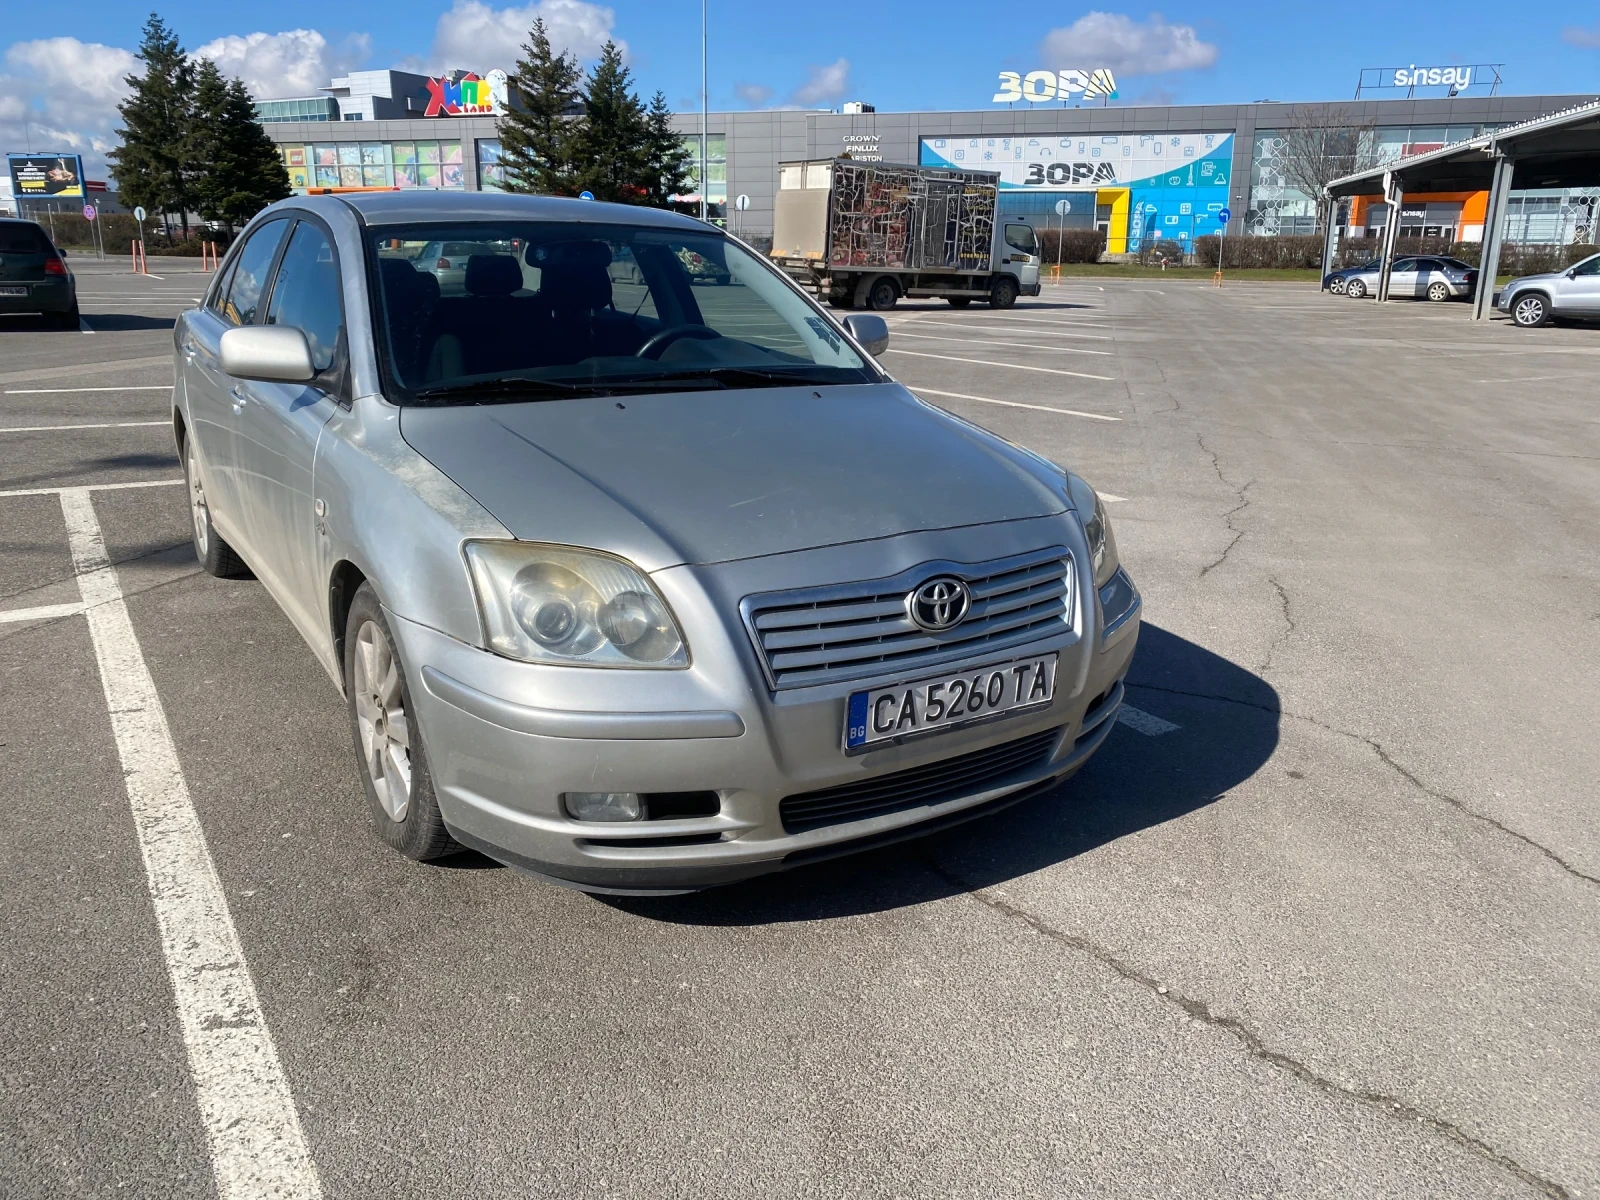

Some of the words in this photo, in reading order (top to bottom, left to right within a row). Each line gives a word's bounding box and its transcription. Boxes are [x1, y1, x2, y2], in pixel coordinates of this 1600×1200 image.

[992, 68, 1117, 103] ЗОРА
[1394, 64, 1471, 90] sinsay
[463, 104, 493, 113] LAND
[1024, 162, 1116, 185] ЗОРА
[1402, 209, 1425, 218] sinsay
[871, 690, 916, 733] CA
[924, 671, 1004, 722] 5260
[1011, 660, 1047, 702] TA
[850, 726, 865, 739] BG
